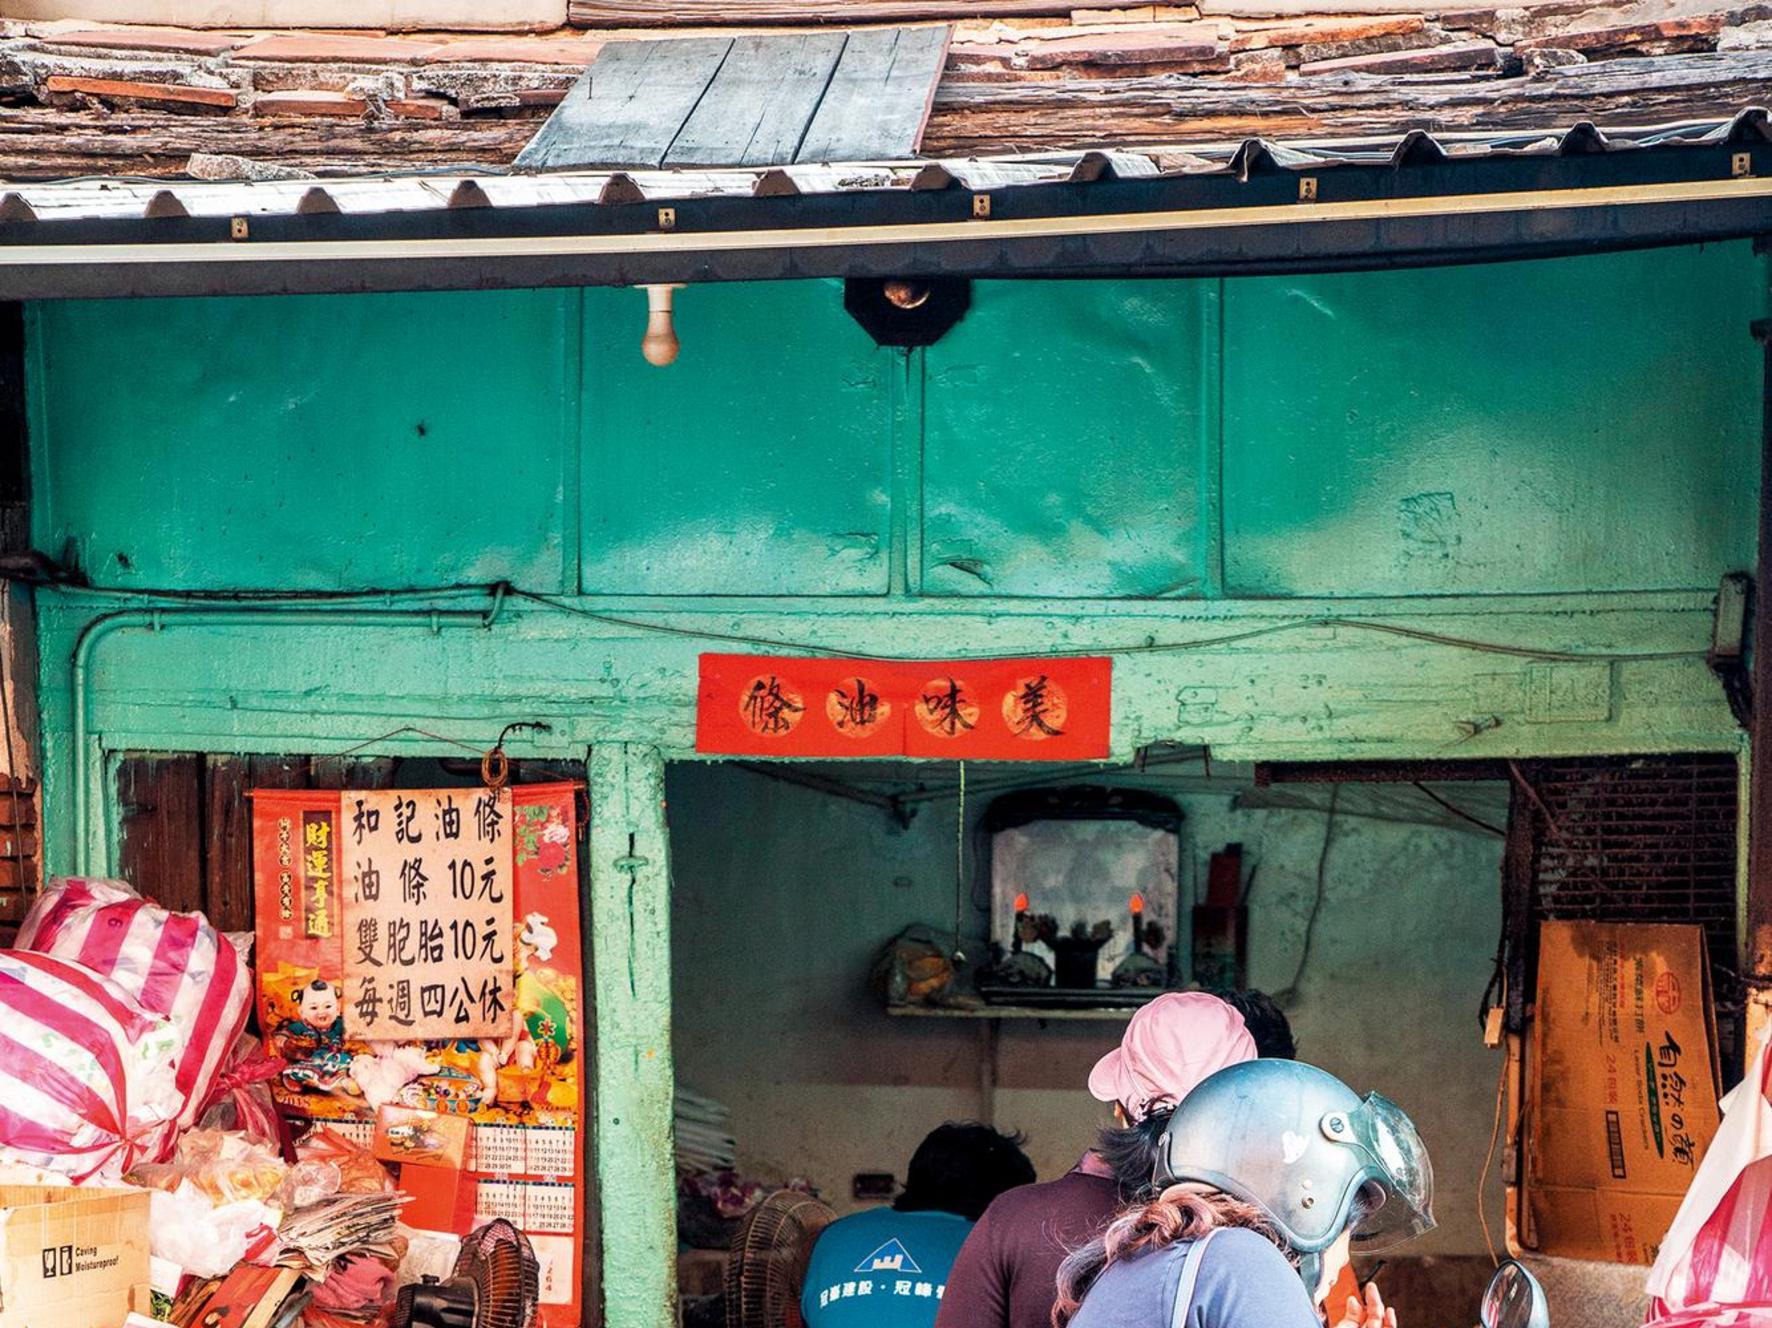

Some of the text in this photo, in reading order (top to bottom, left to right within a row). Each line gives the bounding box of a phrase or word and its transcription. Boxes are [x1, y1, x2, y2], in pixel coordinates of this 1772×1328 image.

[352, 795, 503, 844] 和記油條
[305, 821, 332, 937] 財運亨通
[353, 975, 505, 1026] 每週四公休
